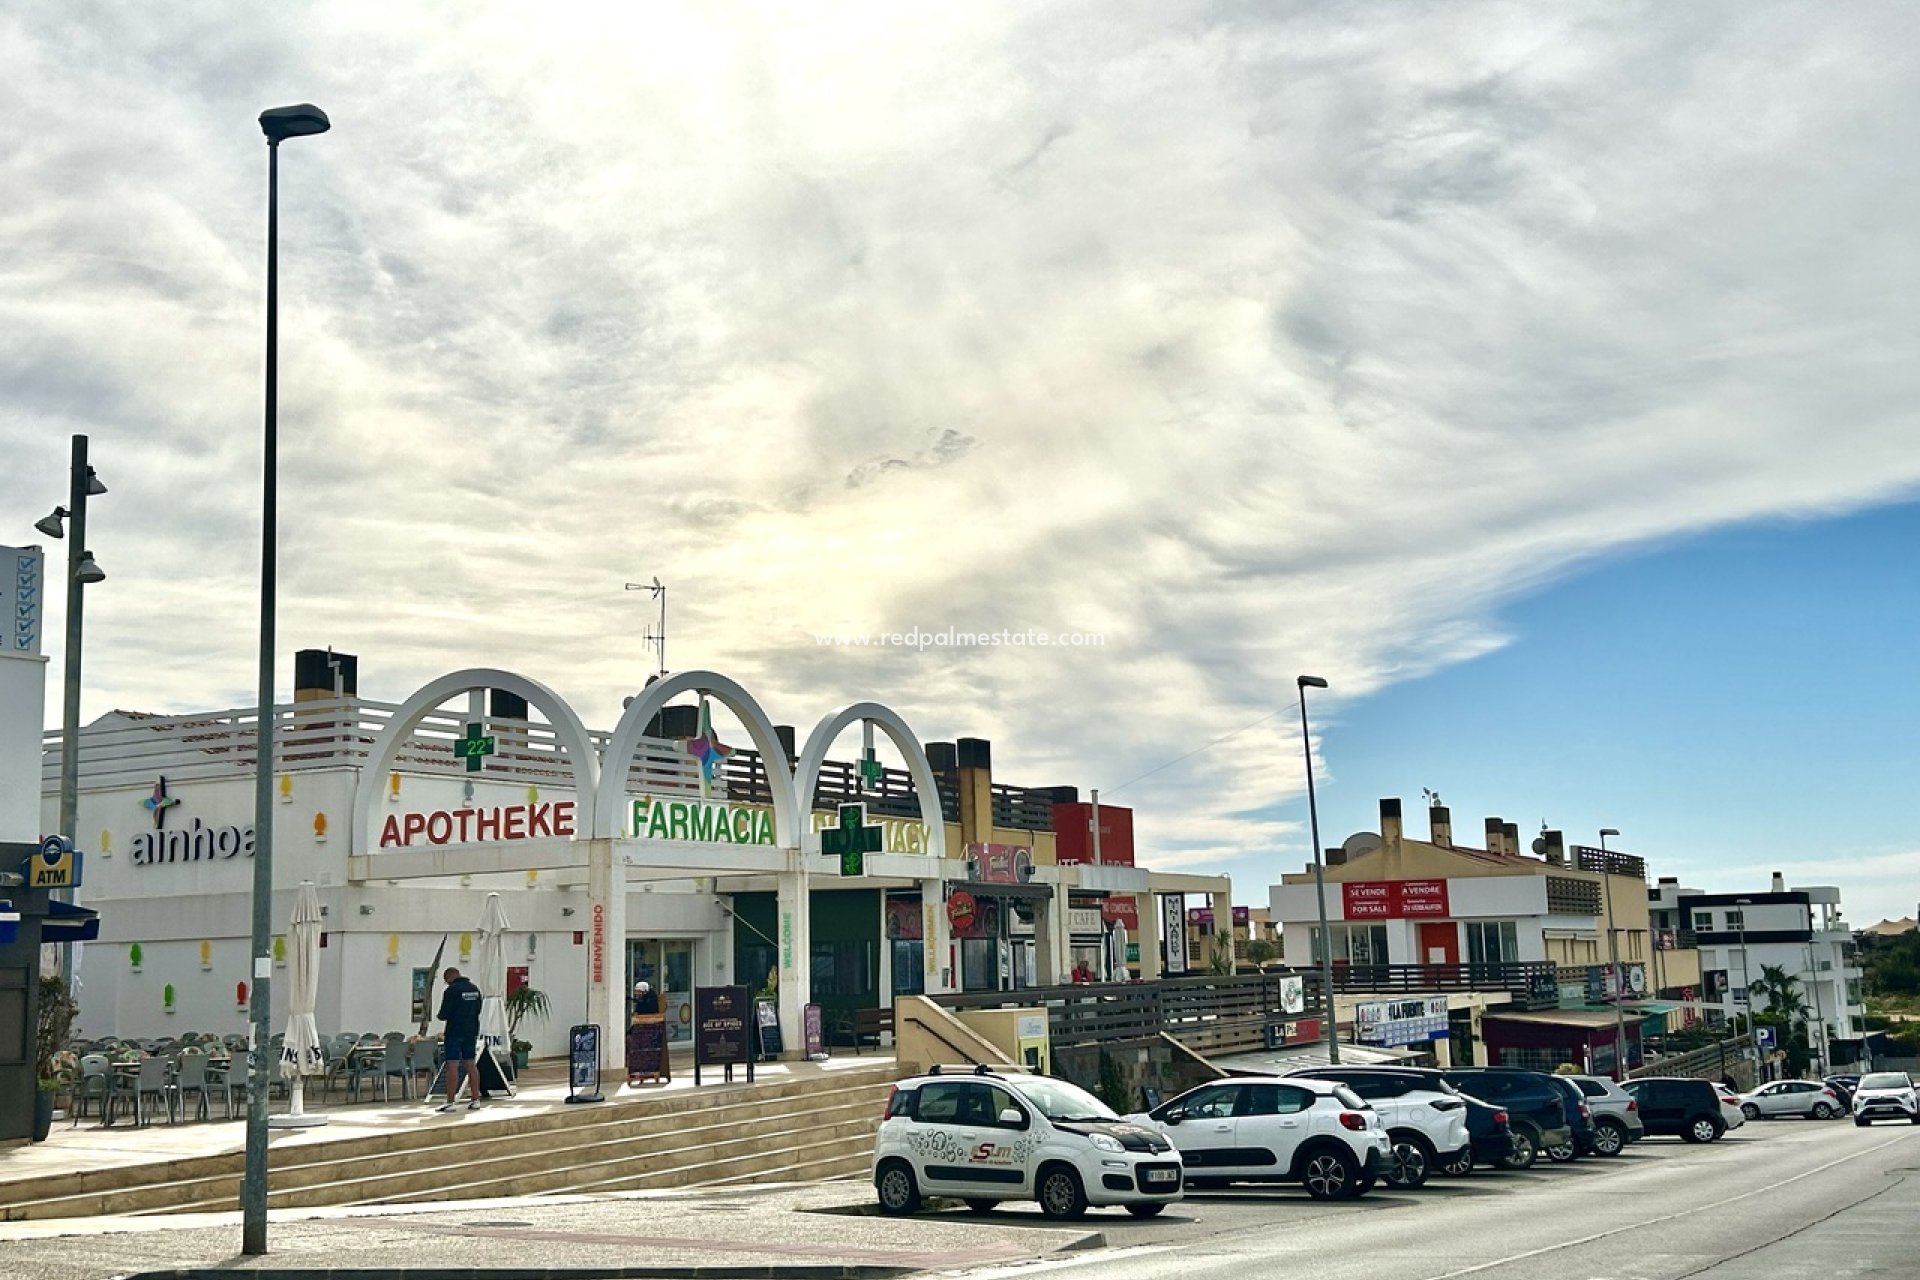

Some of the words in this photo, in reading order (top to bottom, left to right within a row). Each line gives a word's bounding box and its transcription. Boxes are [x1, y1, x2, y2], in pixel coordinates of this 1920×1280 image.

[380, 801, 576, 848] APOTHEKE
[630, 799, 776, 846] FARMACIA
[37, 869, 67, 884] ATM
[1351, 888, 1359, 896] SE
[1360, 888, 1386, 896] VENDE
[1408, 886, 1440, 895] VENDRE
[1352, 906, 1369, 914] FOR
[1370, 905, 1387, 913] SALE
[594, 904, 604, 983] BIENVENIDO
[783, 911, 792, 970] WELCOME
[1756, 1028, 1769, 1046] P
